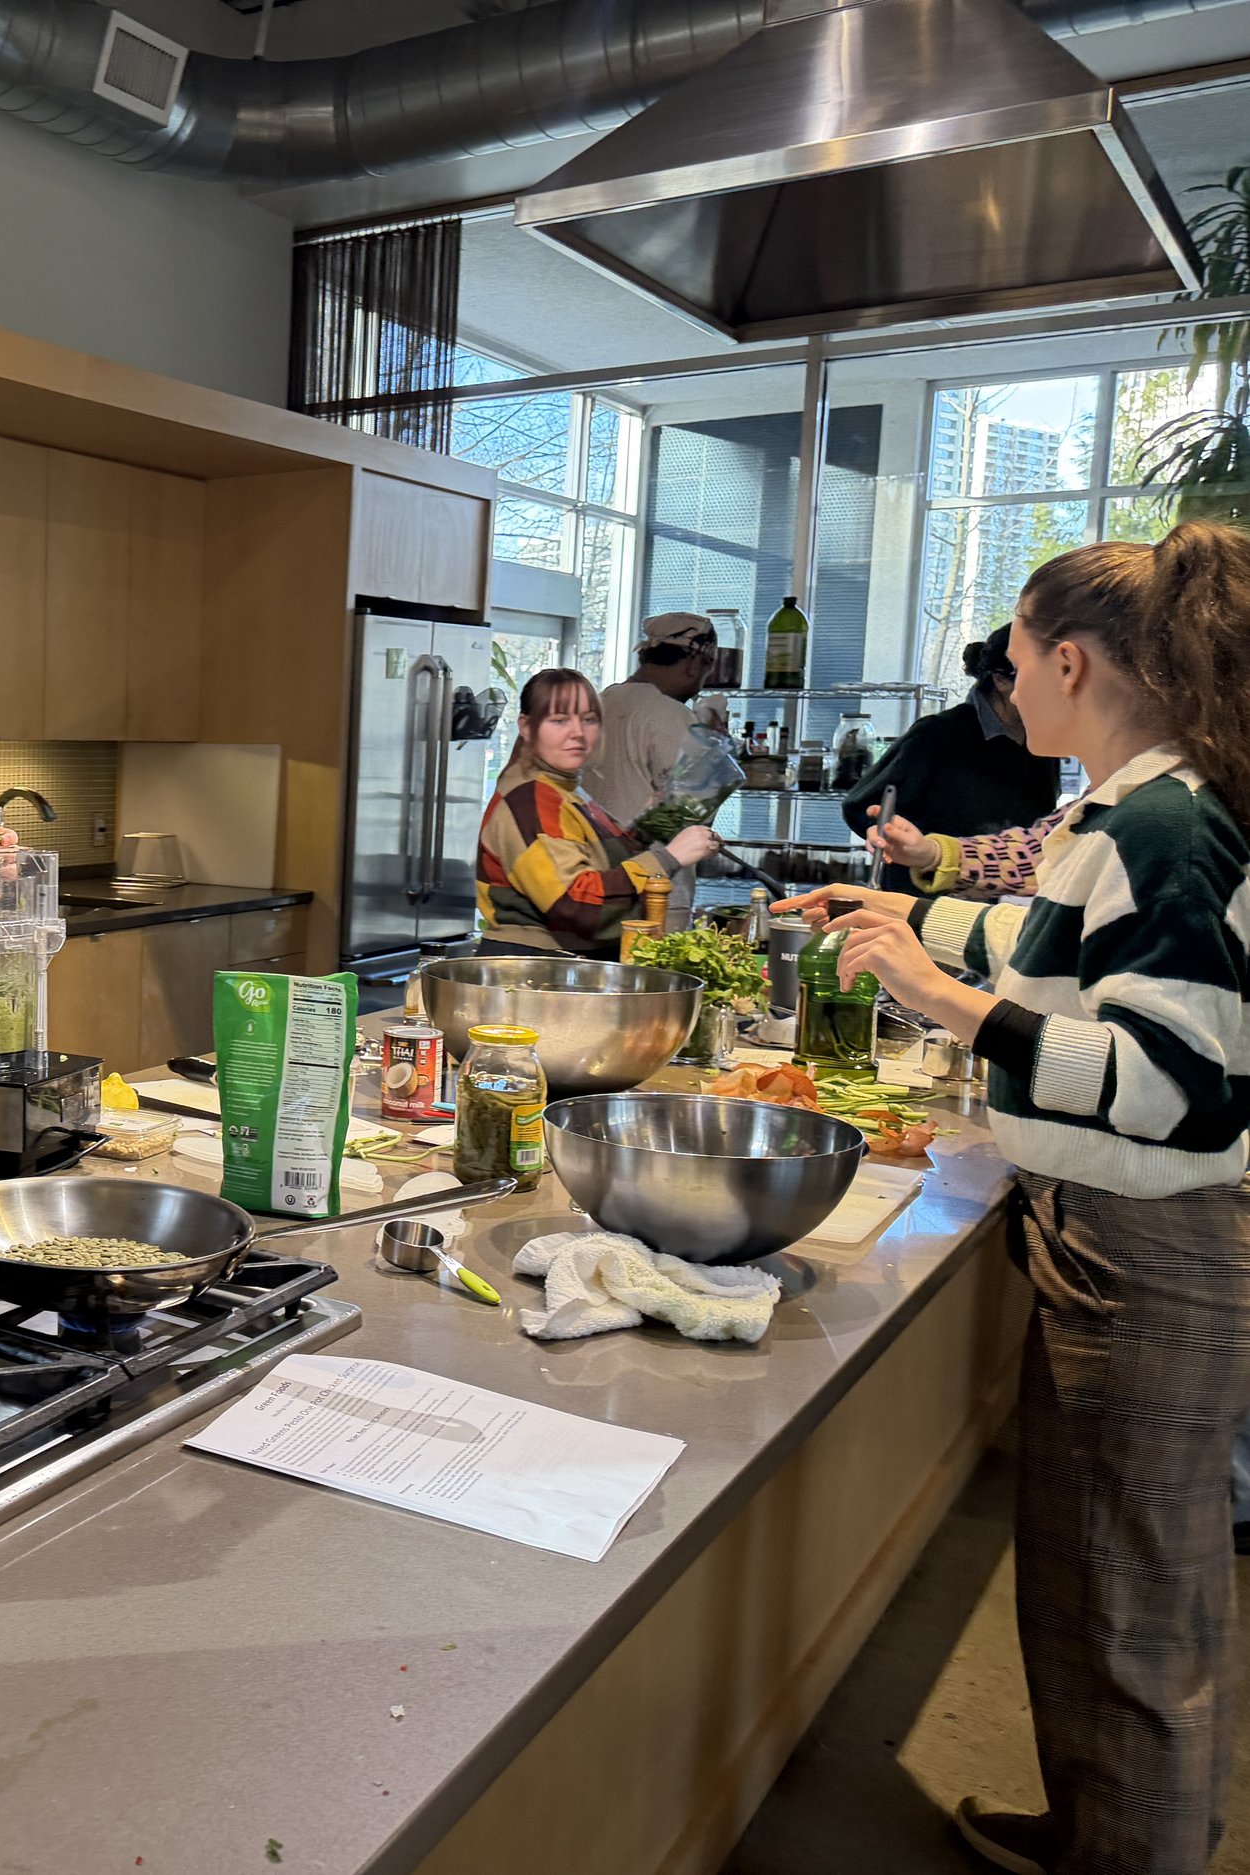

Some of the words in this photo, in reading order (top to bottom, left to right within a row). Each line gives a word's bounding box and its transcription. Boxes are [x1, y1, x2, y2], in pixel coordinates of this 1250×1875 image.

[292, 1004, 317, 1013] Calories
[326, 1007, 342, 1015] 180
[391, 1046, 414, 1058] THAI
[254, 1396, 277, 1411] Green
[271, 1381, 293, 1398] Foods
[248, 1440, 271, 1456] Mixed
[265, 1427, 291, 1443] Greens
[299, 1405, 316, 1416] One
[310, 1396, 326, 1406] Pot
[319, 1377, 344, 1397] Chicken
